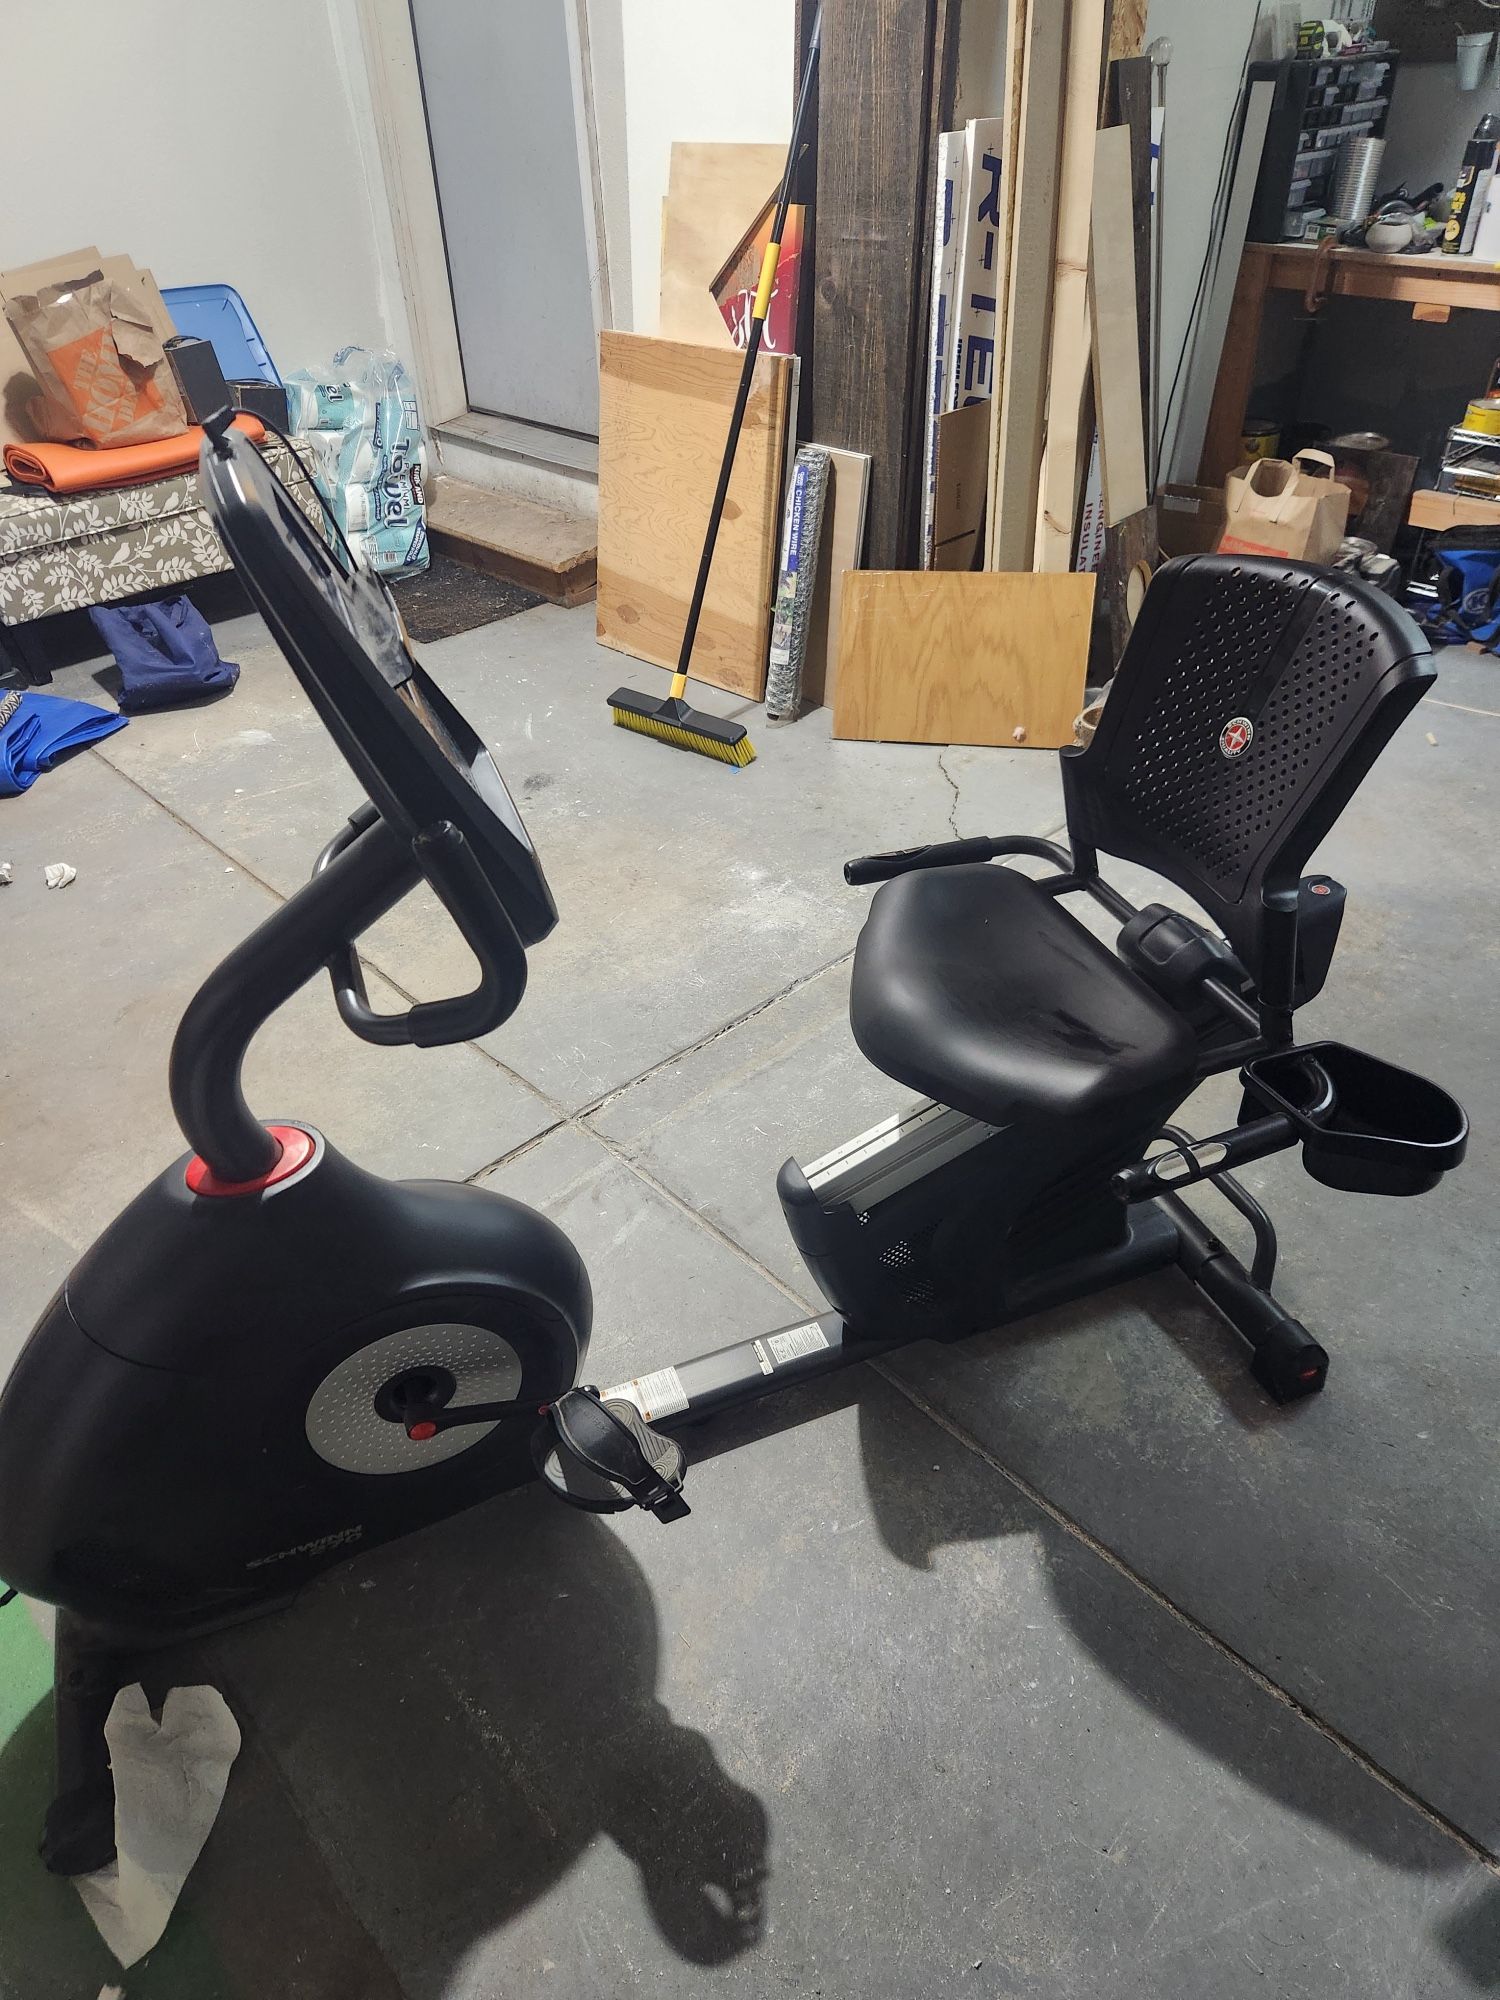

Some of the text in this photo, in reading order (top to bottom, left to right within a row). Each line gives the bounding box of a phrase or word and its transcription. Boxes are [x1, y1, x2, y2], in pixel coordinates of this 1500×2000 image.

[413, 464, 425, 505] KIRKAND
[793, 489, 803, 531] CHICKEN
[789, 532, 800, 556] WIRE
[1090, 499, 1105, 572] ENGINEE
